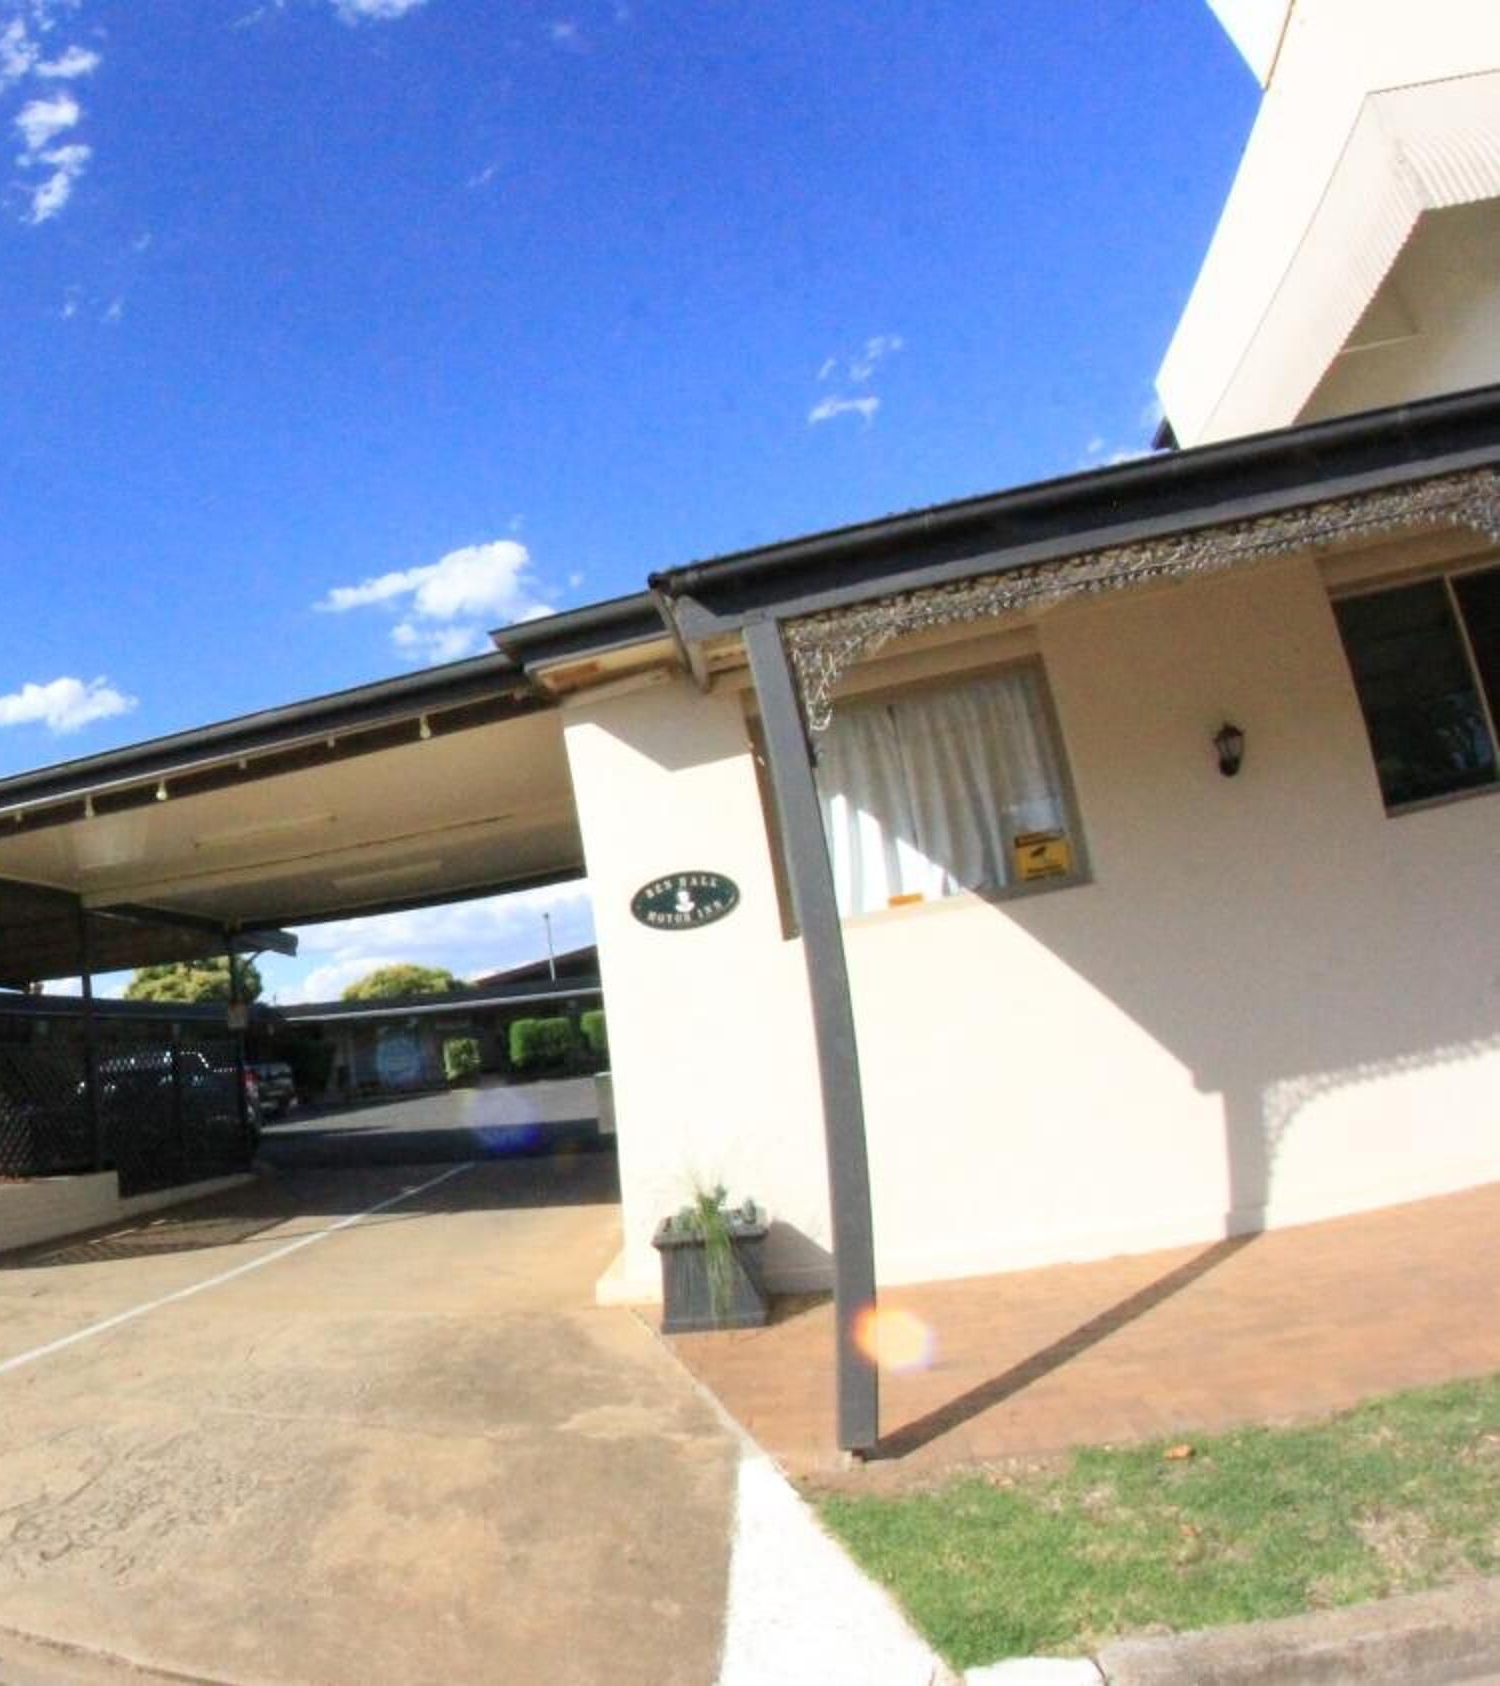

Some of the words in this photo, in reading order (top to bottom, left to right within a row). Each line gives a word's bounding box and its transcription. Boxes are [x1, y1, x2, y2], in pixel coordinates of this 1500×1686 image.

[678, 875, 717, 890] HALL
[647, 911, 692, 923] MOTOR
[697, 900, 722, 919] INN
